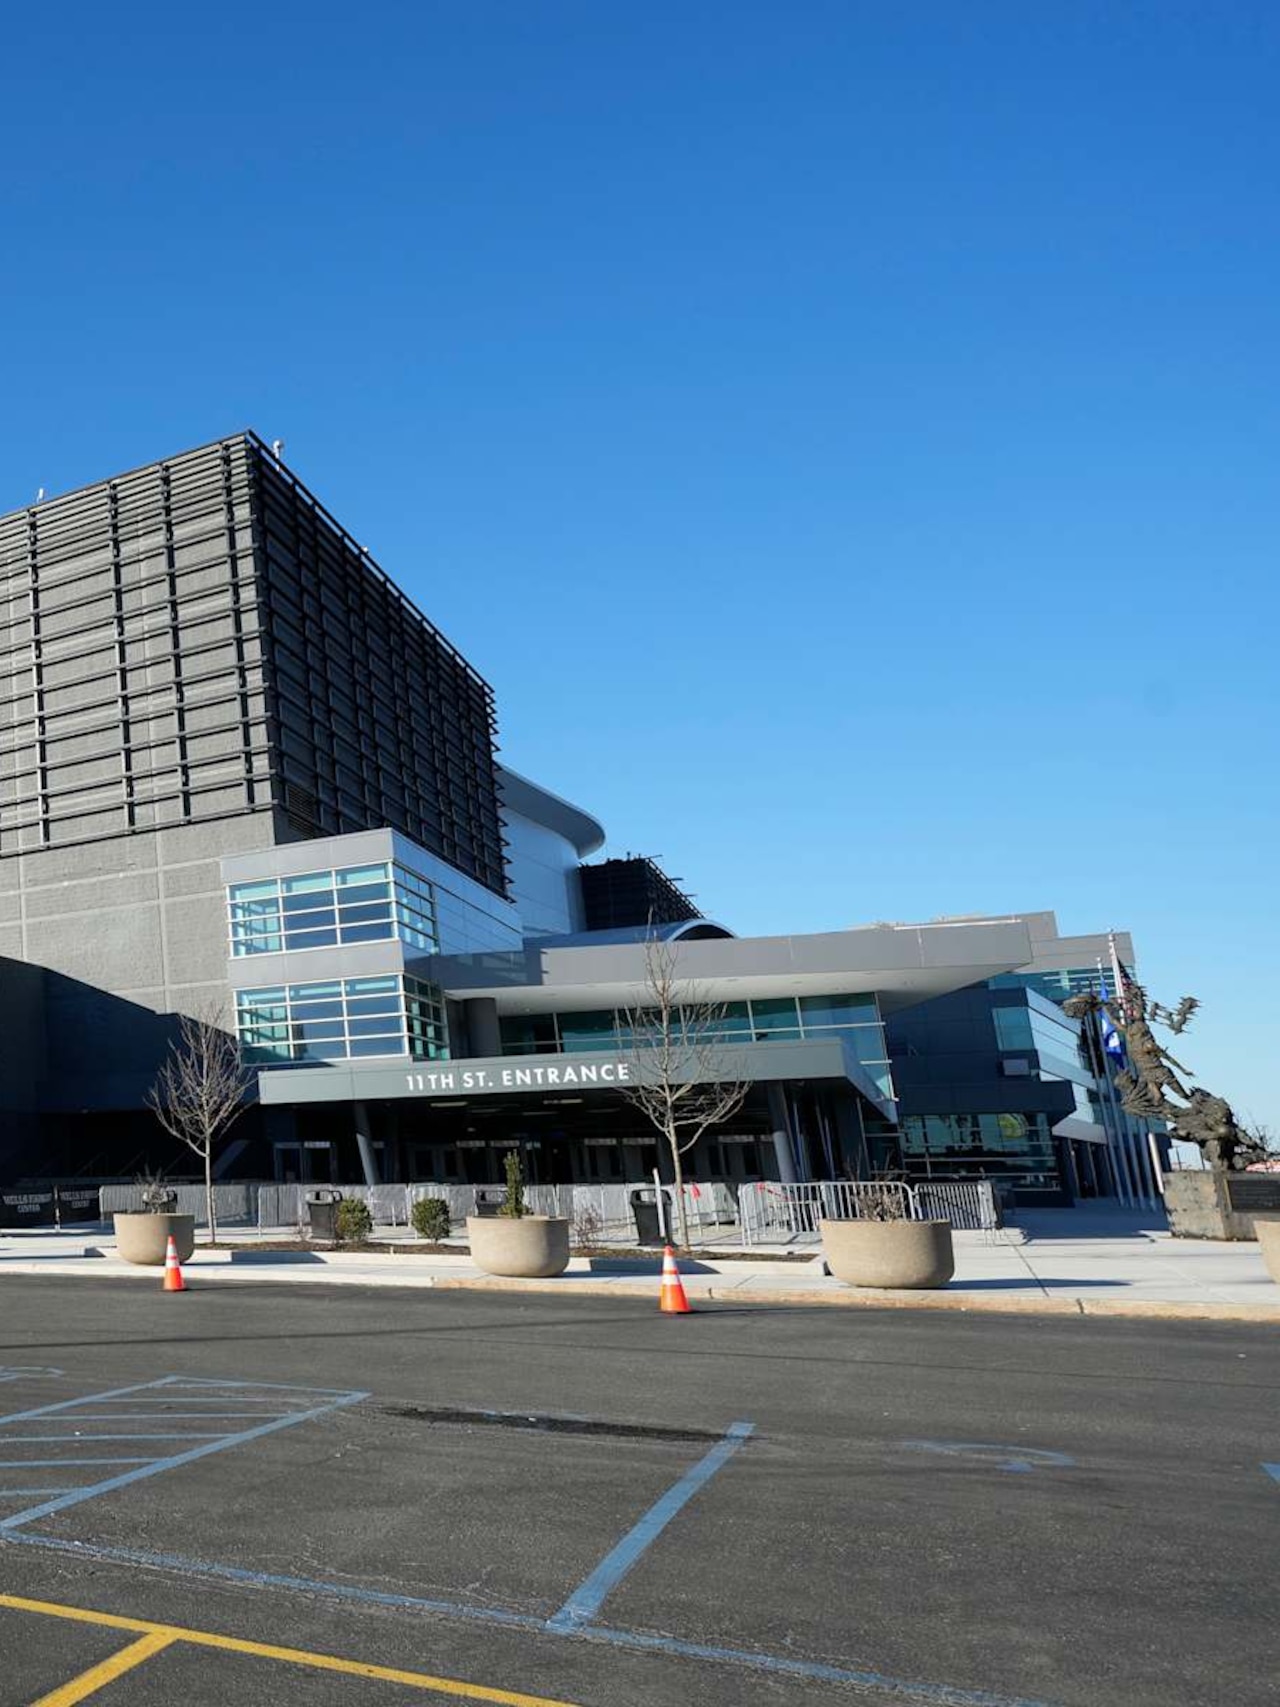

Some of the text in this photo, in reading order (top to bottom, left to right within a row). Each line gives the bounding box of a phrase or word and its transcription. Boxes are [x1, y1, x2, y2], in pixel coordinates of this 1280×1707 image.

[406, 1063, 629, 1091] 11TH ST. ENTRANCE
